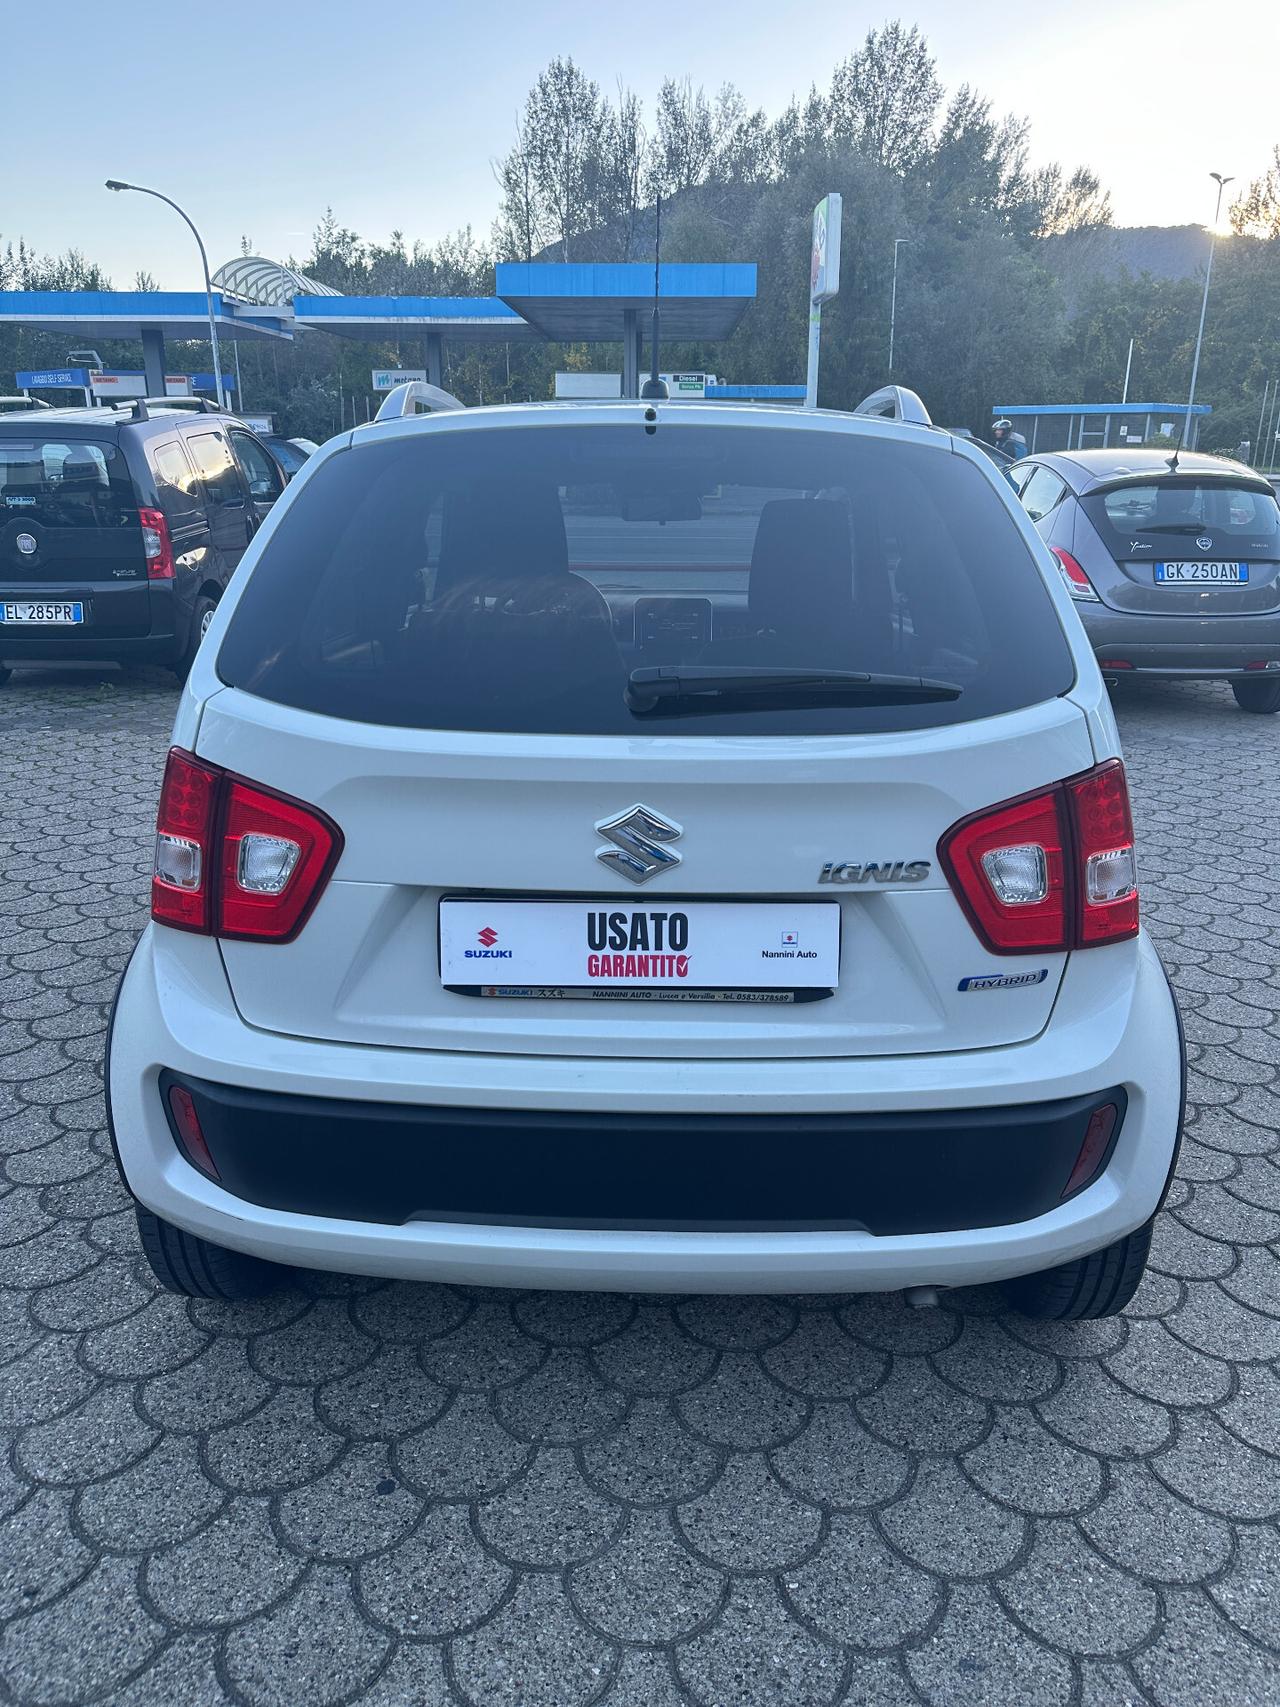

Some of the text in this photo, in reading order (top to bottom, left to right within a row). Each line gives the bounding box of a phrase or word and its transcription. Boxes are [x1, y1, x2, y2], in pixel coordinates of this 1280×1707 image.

[393, 376, 421, 384] metano
[1166, 564, 1238, 579] GK 250AN
[6, 605, 72, 620] EL 285PR
[587, 912, 689, 951] USATO
[464, 950, 512, 958] SUZUKI
[761, 950, 818, 959] Nannini Auto
[587, 954, 692, 977] GARANTITO
[973, 974, 1037, 989] HYBRID
[498, 988, 533, 996] SUZUKI
[537, 988, 565, 998] スズキ
[592, 990, 628, 998] NANNINI
[630, 991, 652, 999] AUTO
[659, 991, 679, 999] Lucca
